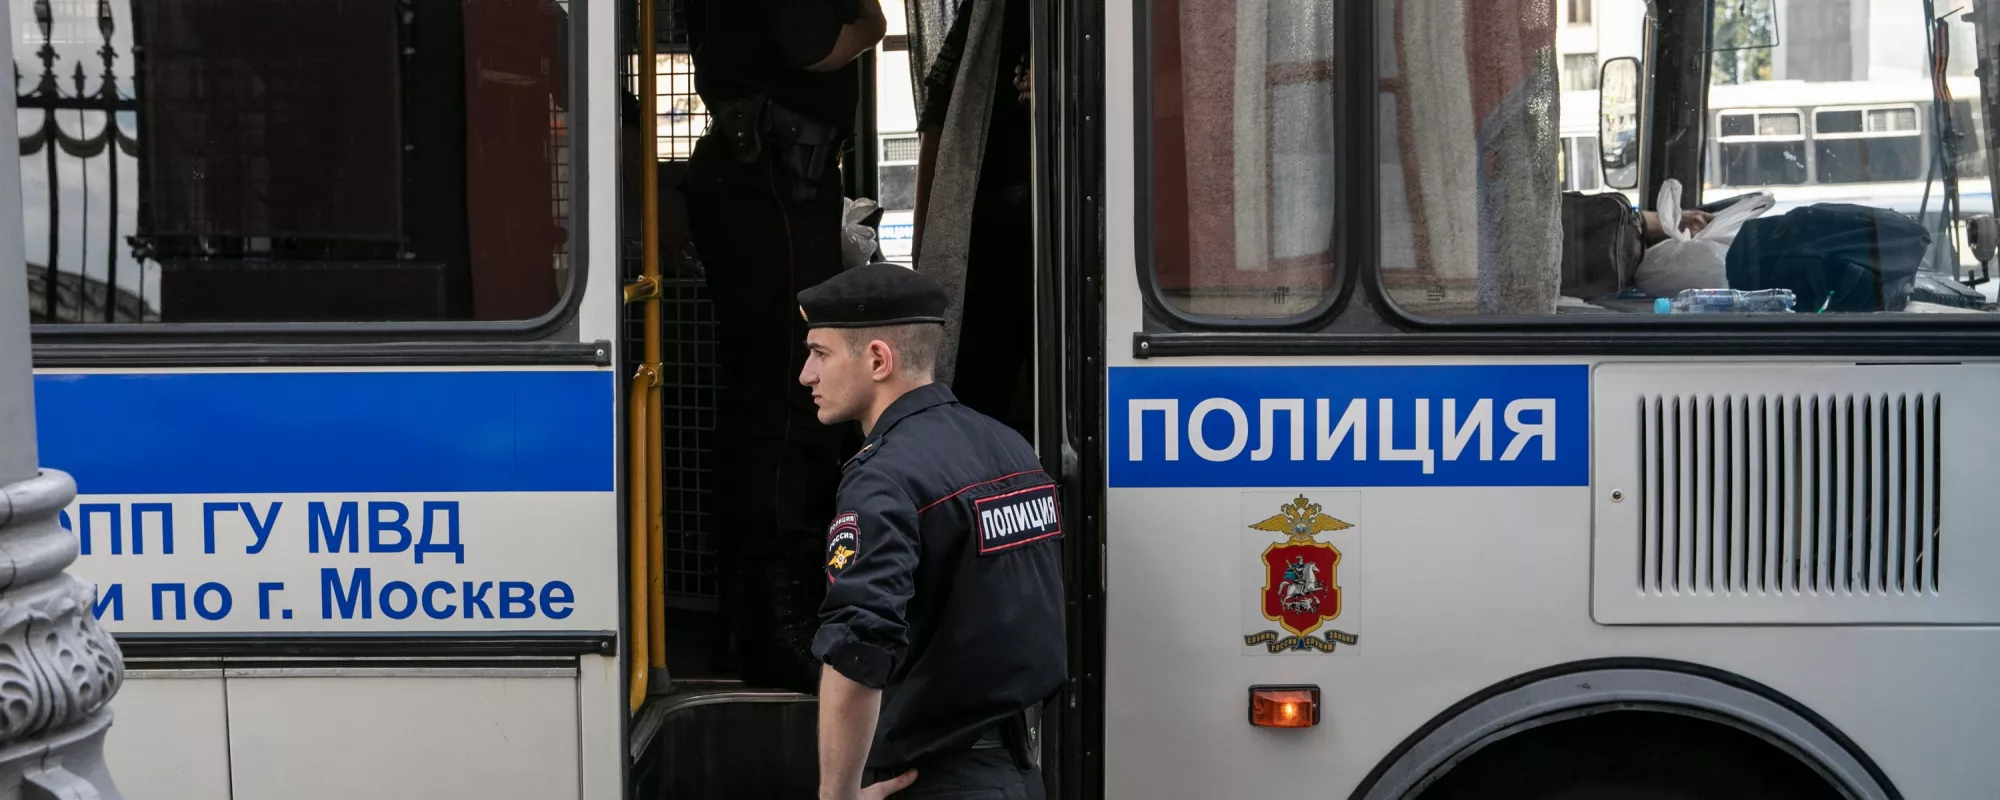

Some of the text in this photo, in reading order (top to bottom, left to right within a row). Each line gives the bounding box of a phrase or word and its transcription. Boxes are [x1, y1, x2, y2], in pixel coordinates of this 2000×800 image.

[1128, 397, 1557, 474] ПОЛИЦИЯ
[59, 501, 465, 564] ПП ГУ МВД
[981, 495, 1057, 540] ПОЛИЦИЯ
[151, 580, 233, 621] по
[258, 582, 293, 620] г.
[320, 567, 575, 621] Москве
